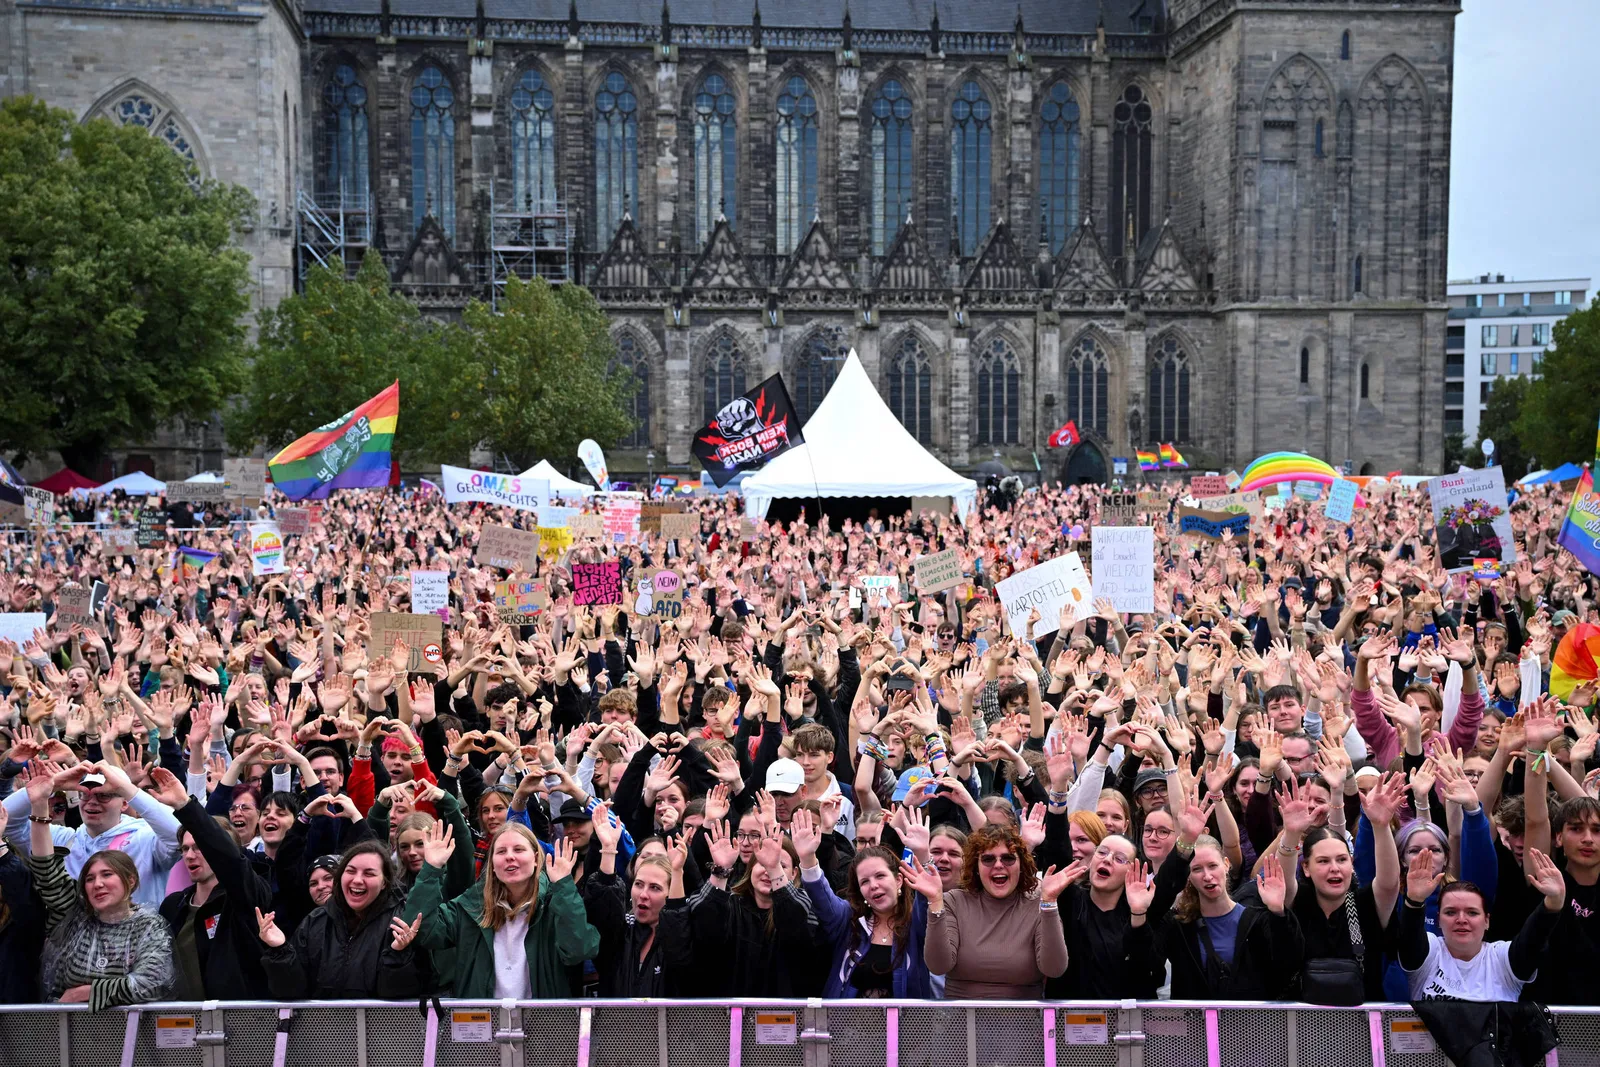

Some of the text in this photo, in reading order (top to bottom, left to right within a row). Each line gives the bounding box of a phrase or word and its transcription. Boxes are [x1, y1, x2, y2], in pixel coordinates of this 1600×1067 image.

[470, 474, 522, 494] OMAS
[1441, 478, 1464, 488] Bunt
[1450, 481, 1494, 496] Grauland
[24, 486, 52, 502] NIE WIEDER
[1102, 495, 1136, 506] NEIN
[36, 502, 44, 510] IST
[1204, 493, 1257, 509] SOGAR ICH
[1103, 506, 1137, 518] PATRIK
[1096, 530, 1148, 544] WIRTSCHAFT
[916, 560, 932, 569] THIS
[938, 550, 955, 563] WHAT
[920, 562, 957, 579] DEMOCRACY
[1104, 564, 1147, 577] VIELFALT
[658, 576, 678, 588] NEIN!
[923, 570, 960, 588] LOOKS LIKE
[1100, 582, 1118, 593] AFD
[656, 600, 682, 618] AfD
[56, 614, 94, 626] MEINUNG
[500, 616, 540, 625] MENSCHEN
